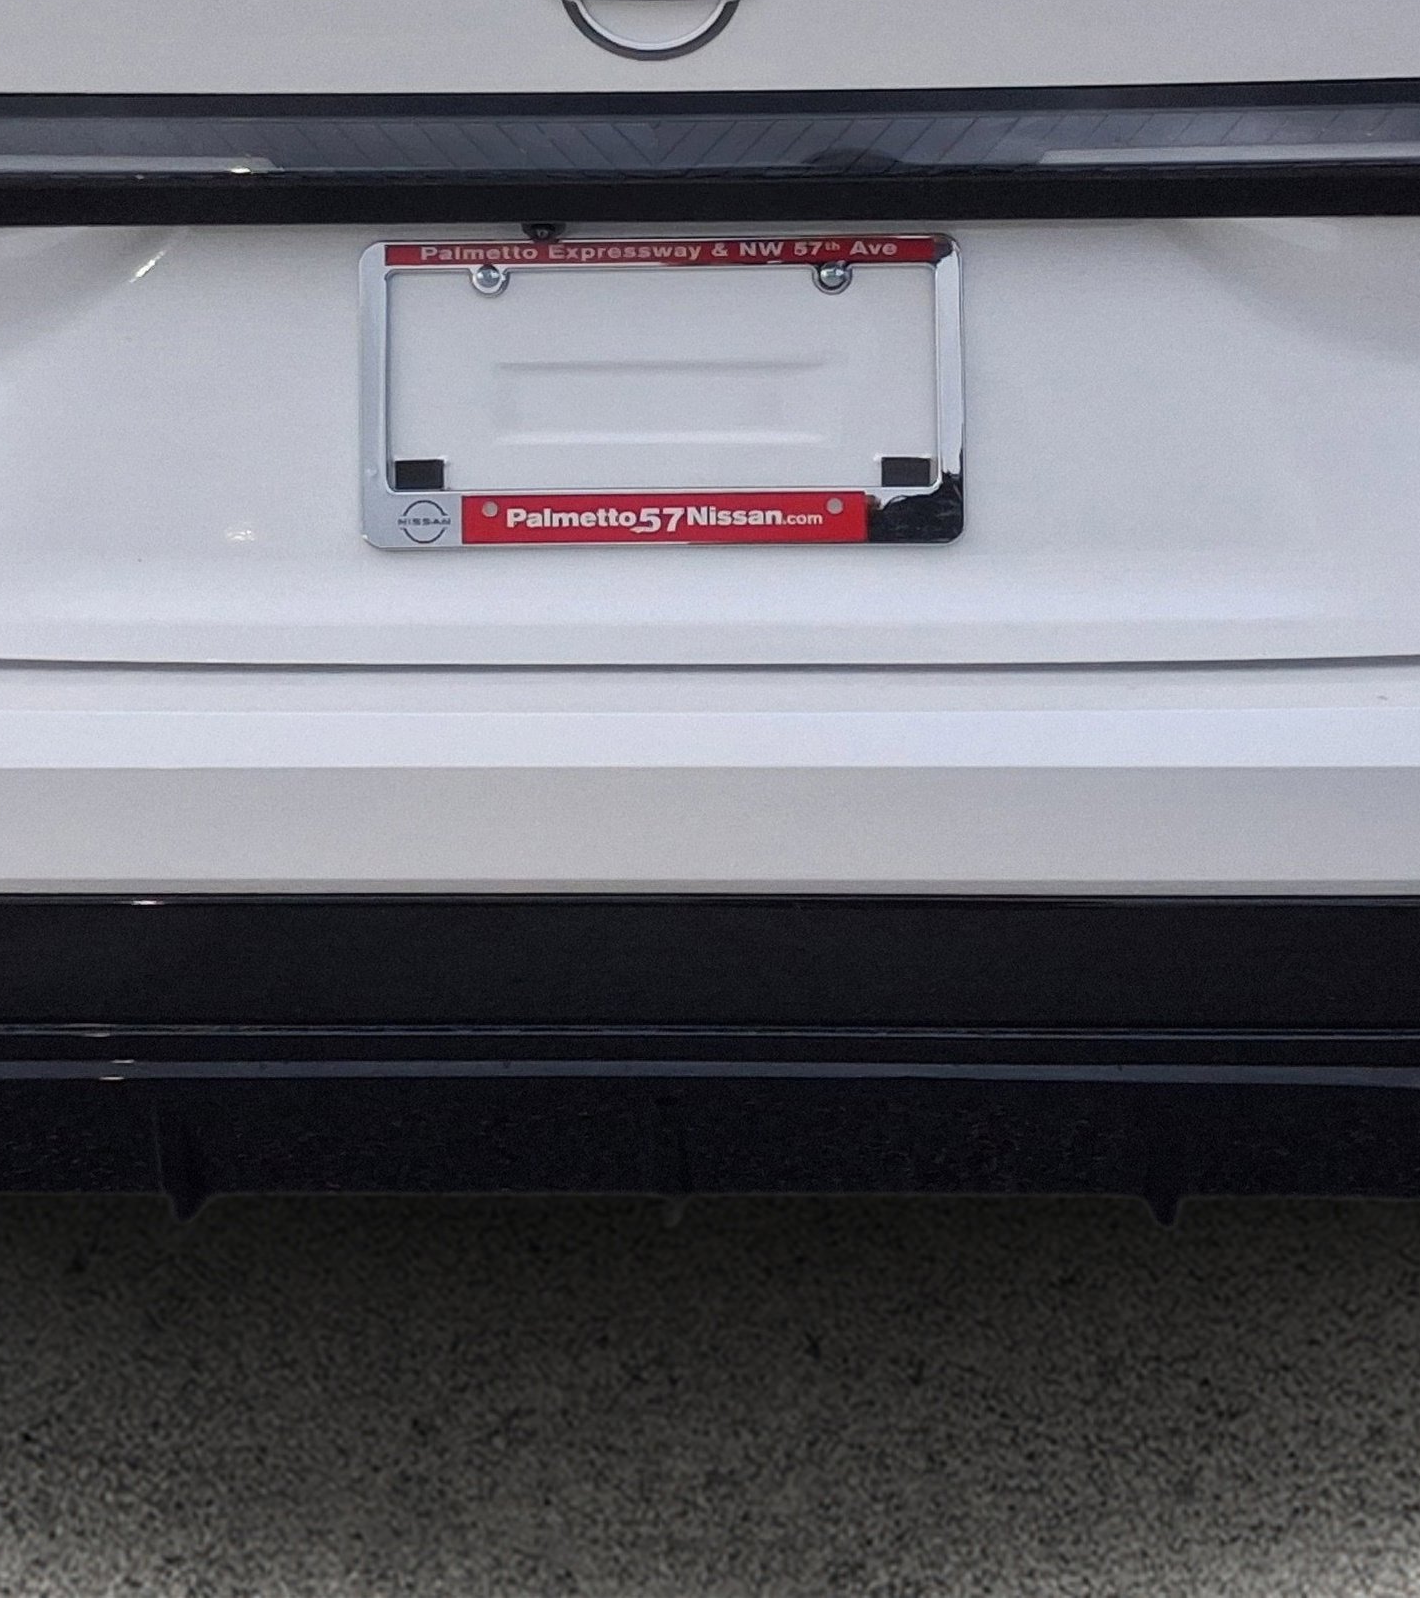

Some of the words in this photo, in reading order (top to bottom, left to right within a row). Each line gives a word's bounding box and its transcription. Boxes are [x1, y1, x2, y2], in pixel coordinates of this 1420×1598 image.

[420, 246, 539, 261] Palmetto
[548, 244, 702, 262] Expressway
[711, 242, 729, 257] &
[739, 241, 784, 257] NW
[794, 240, 841, 256] 57th
[850, 240, 898, 256] Ave
[506, 506, 824, 534] Palmetto57Nissan.com
